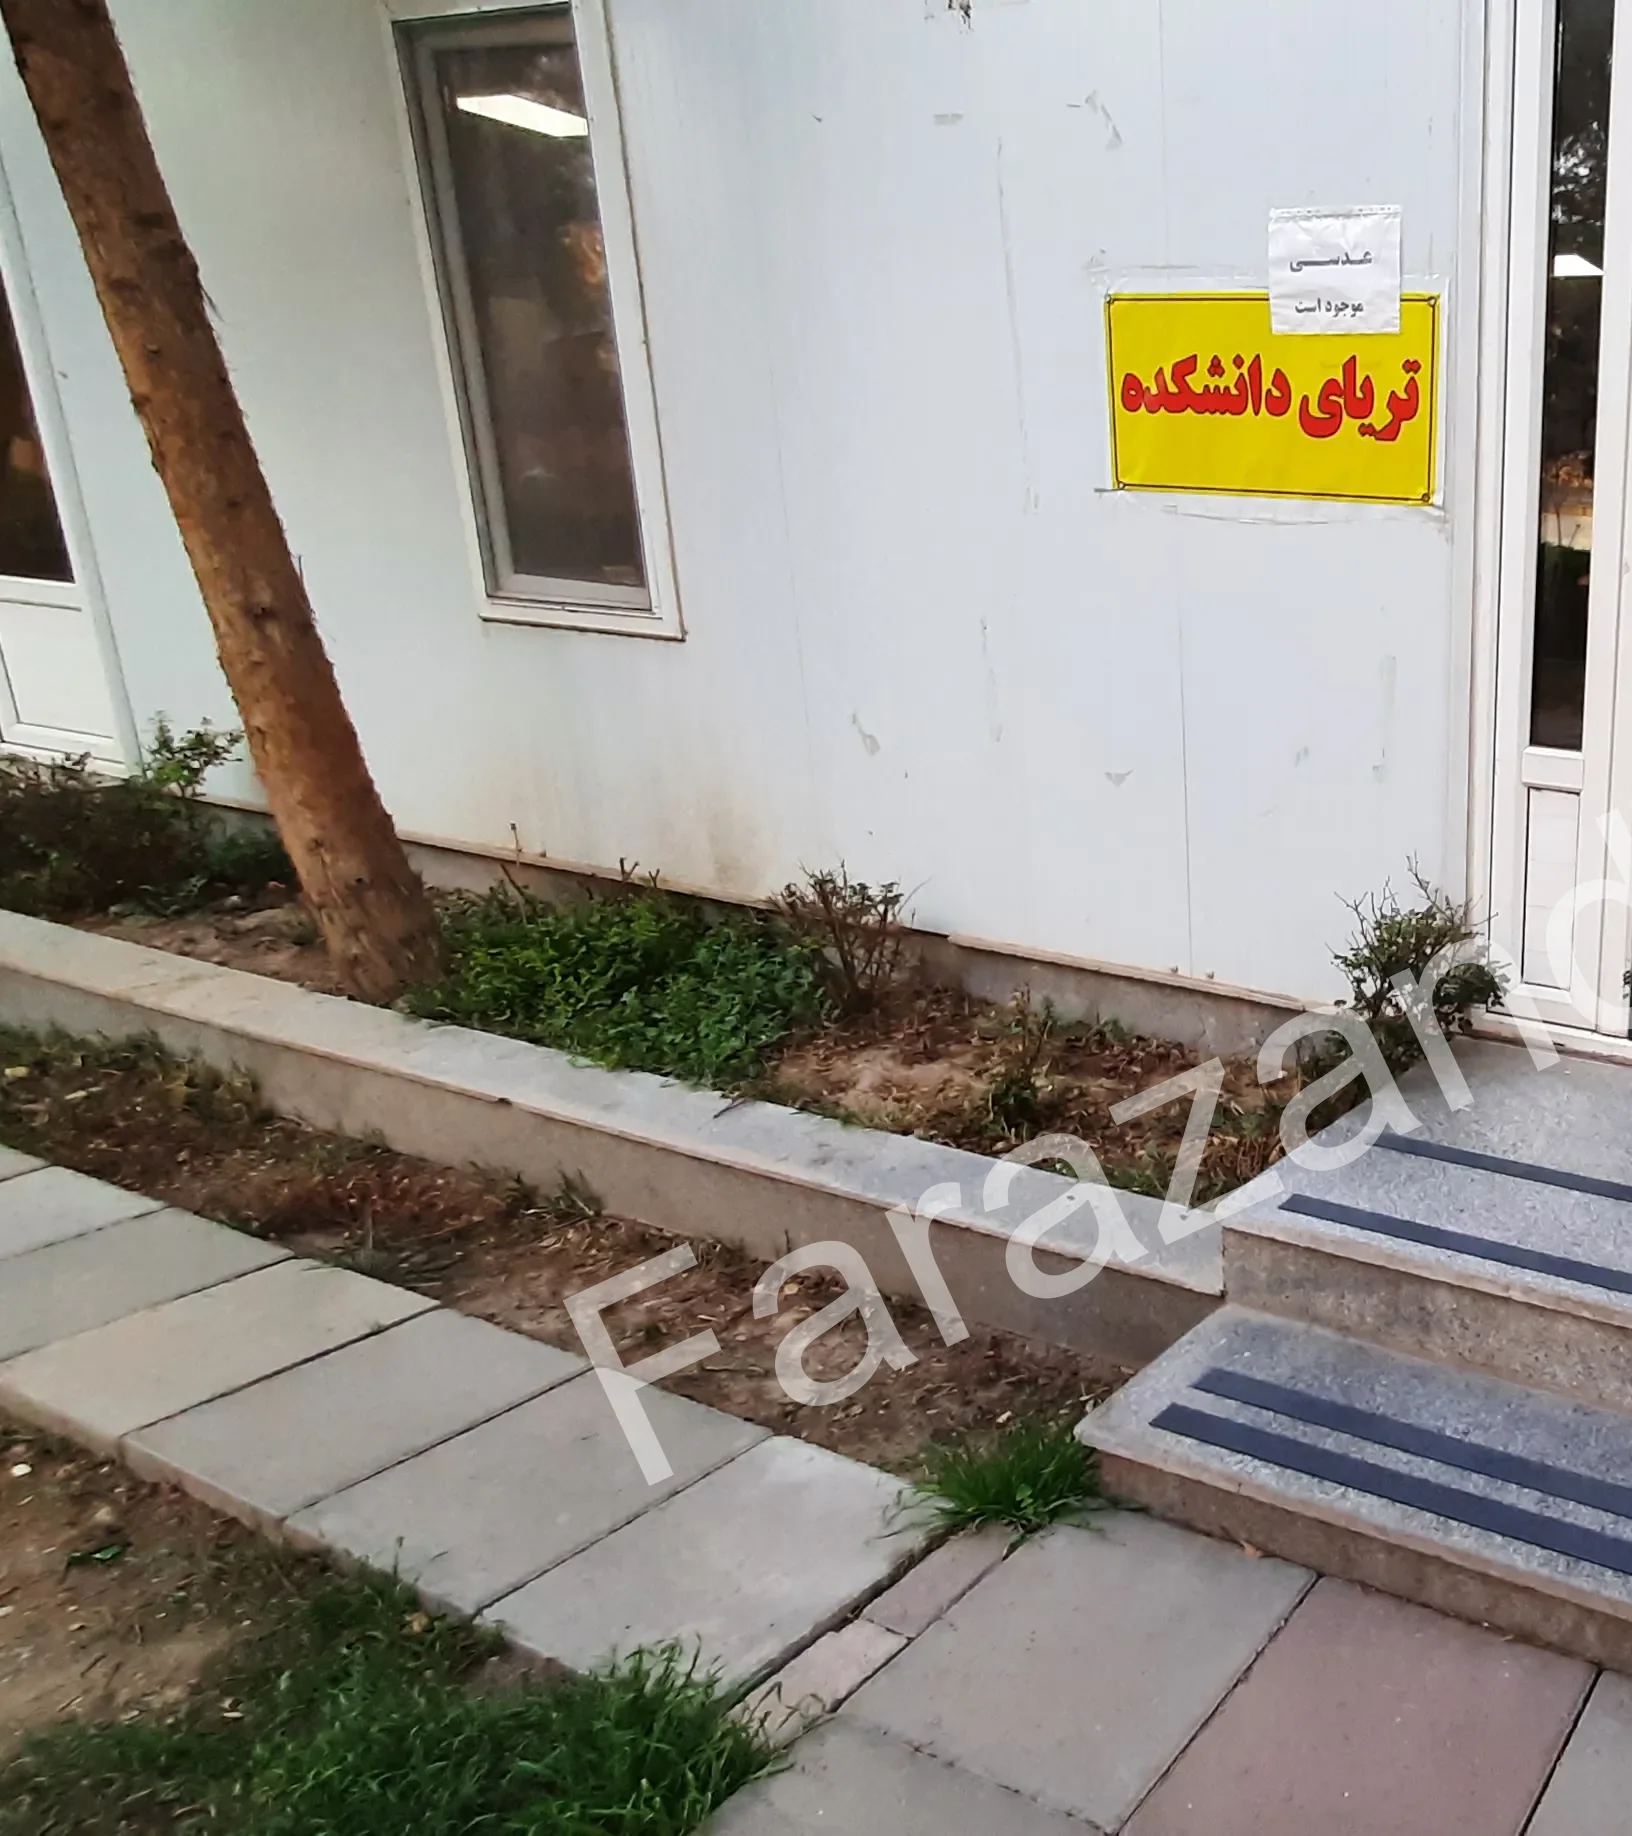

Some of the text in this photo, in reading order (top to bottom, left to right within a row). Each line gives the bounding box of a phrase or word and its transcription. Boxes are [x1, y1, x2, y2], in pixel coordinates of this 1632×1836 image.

[1290, 250, 1372, 273] عدسی
[1295, 297, 1364, 318] موجود است
[1120, 353, 1422, 442] تریای دانشکده
